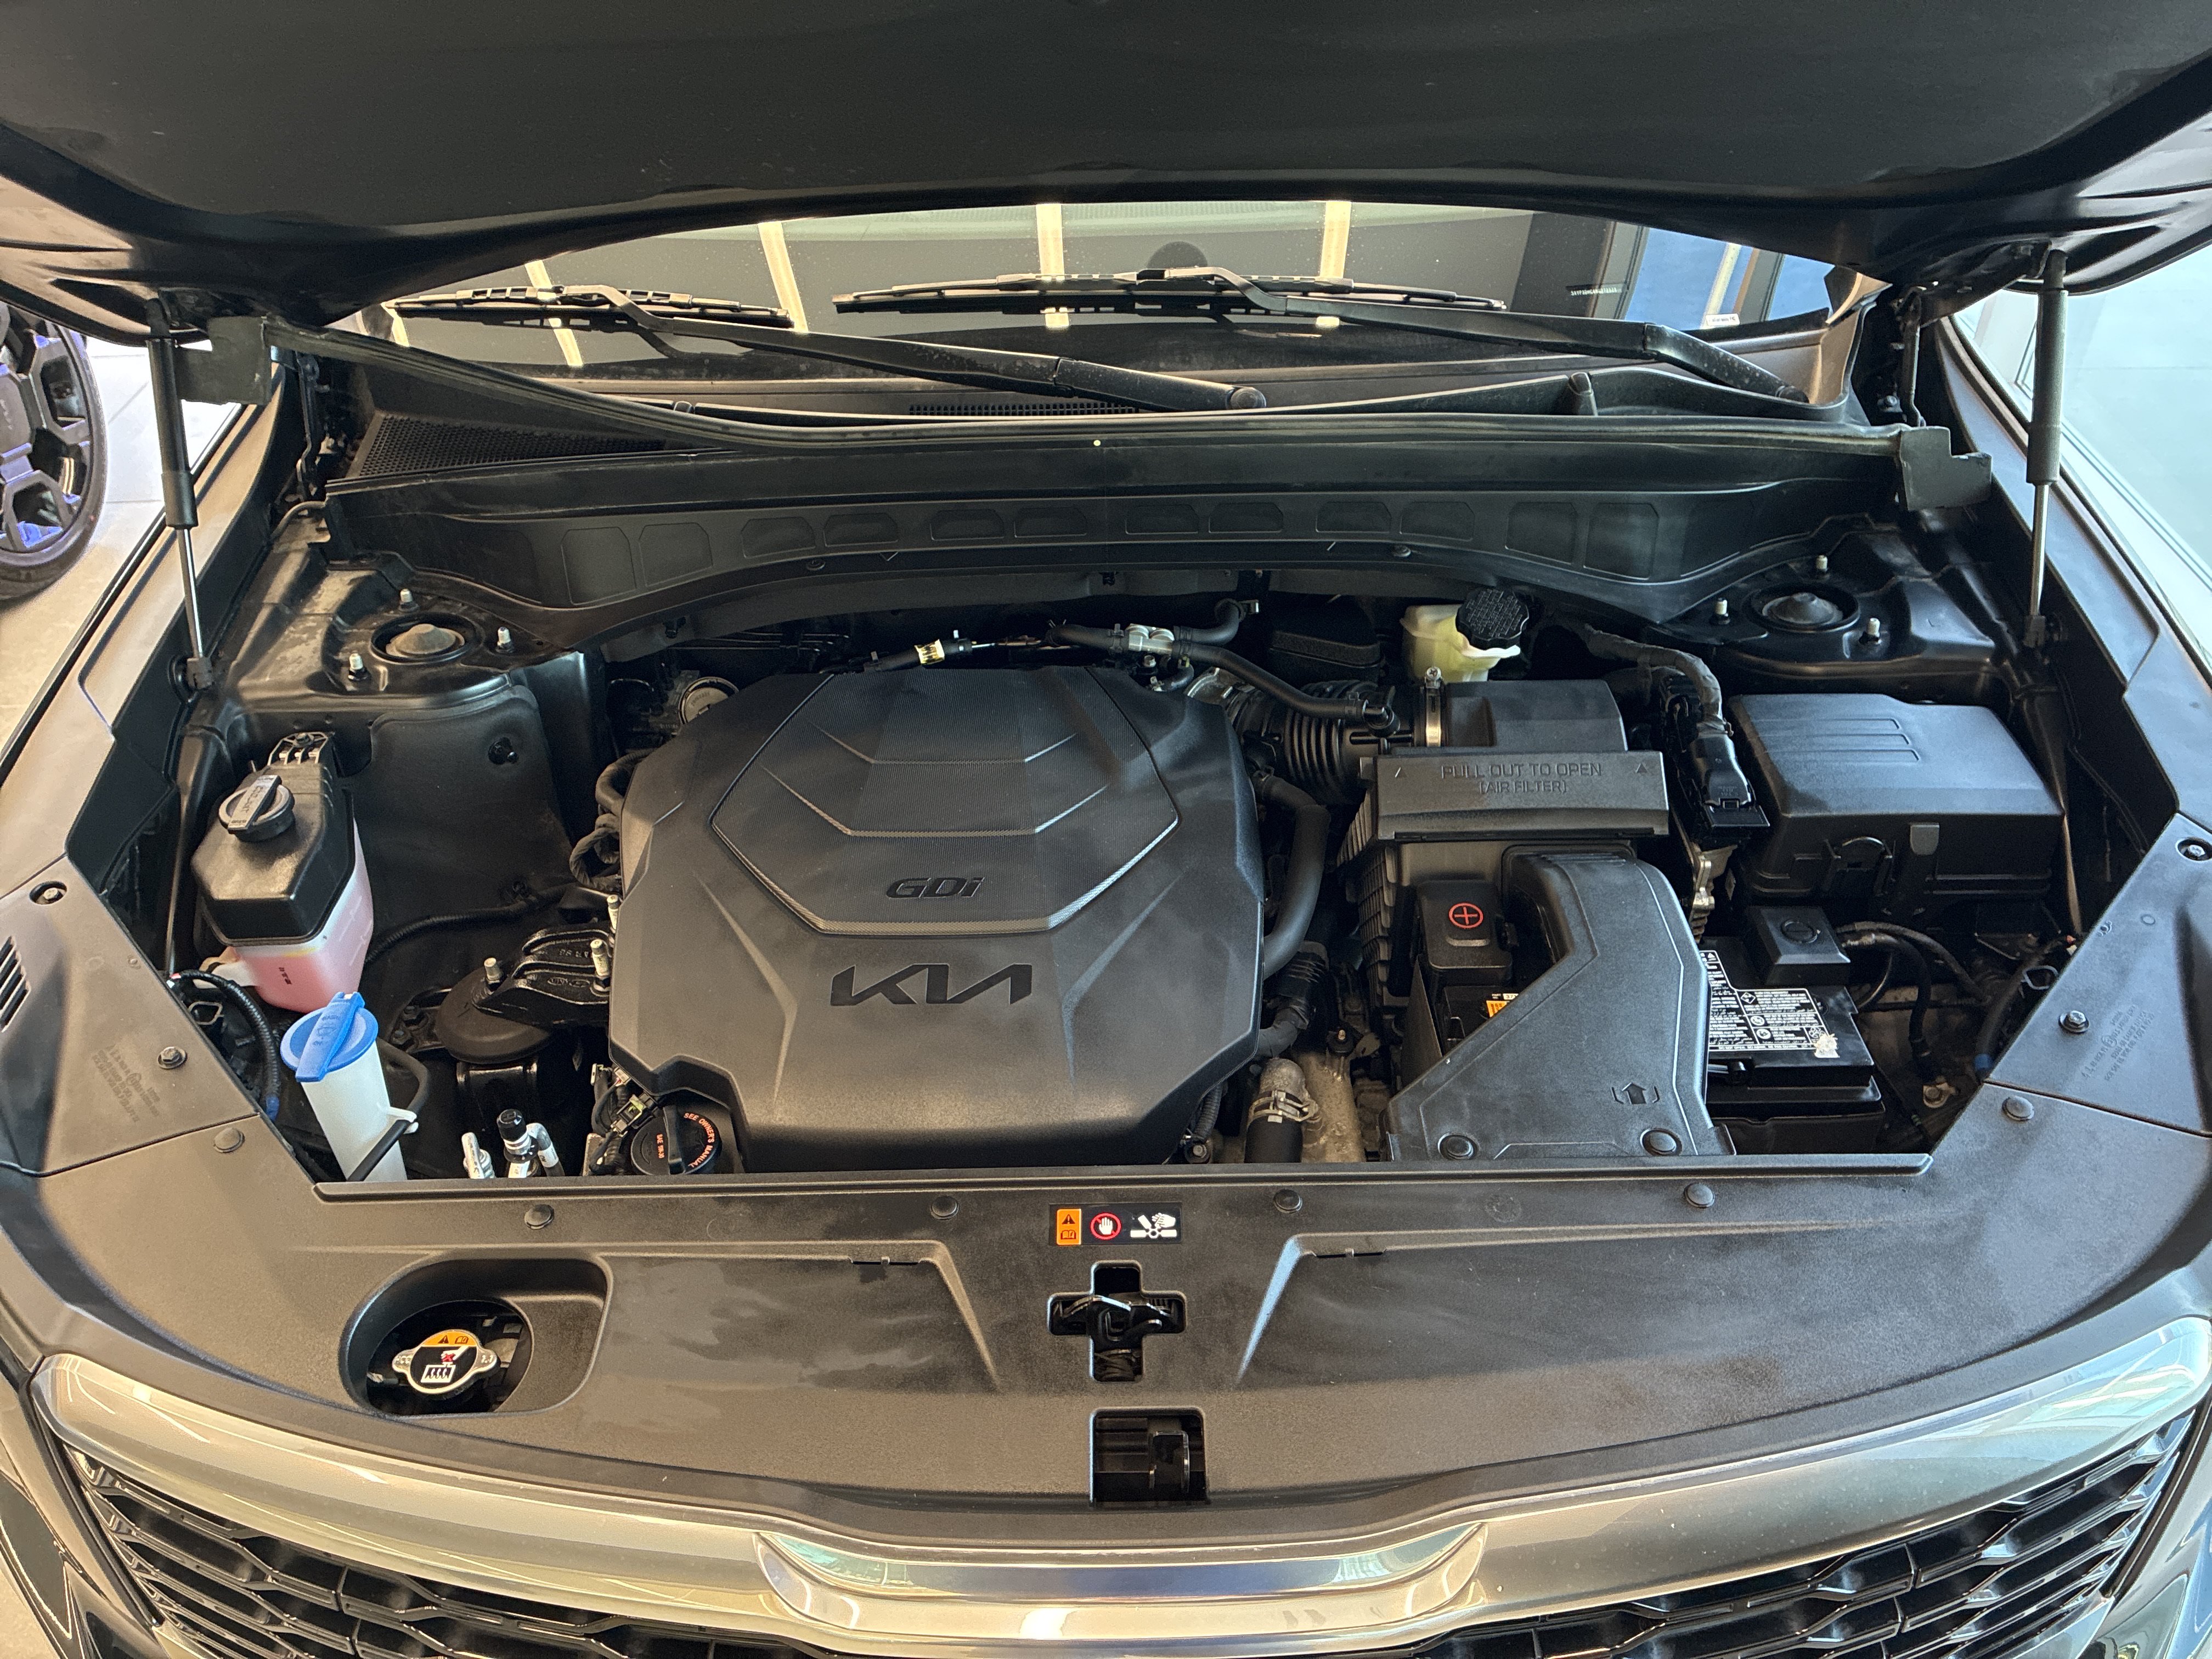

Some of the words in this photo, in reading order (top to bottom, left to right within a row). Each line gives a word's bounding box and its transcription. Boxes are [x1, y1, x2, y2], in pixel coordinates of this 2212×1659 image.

[1441, 763, 1485, 779] PULL
[1488, 763, 1523, 777] OUT
[1527, 762, 1551, 777] TO
[1555, 761, 1602, 777] OPEN
[886, 877, 985, 898] GDi
[830, 963, 1032, 1006] KIA
[684, 1113, 699, 1121] SEE
[698, 1118, 715, 1143] OWNER'S
[687, 1145, 713, 1168] MANUAL
